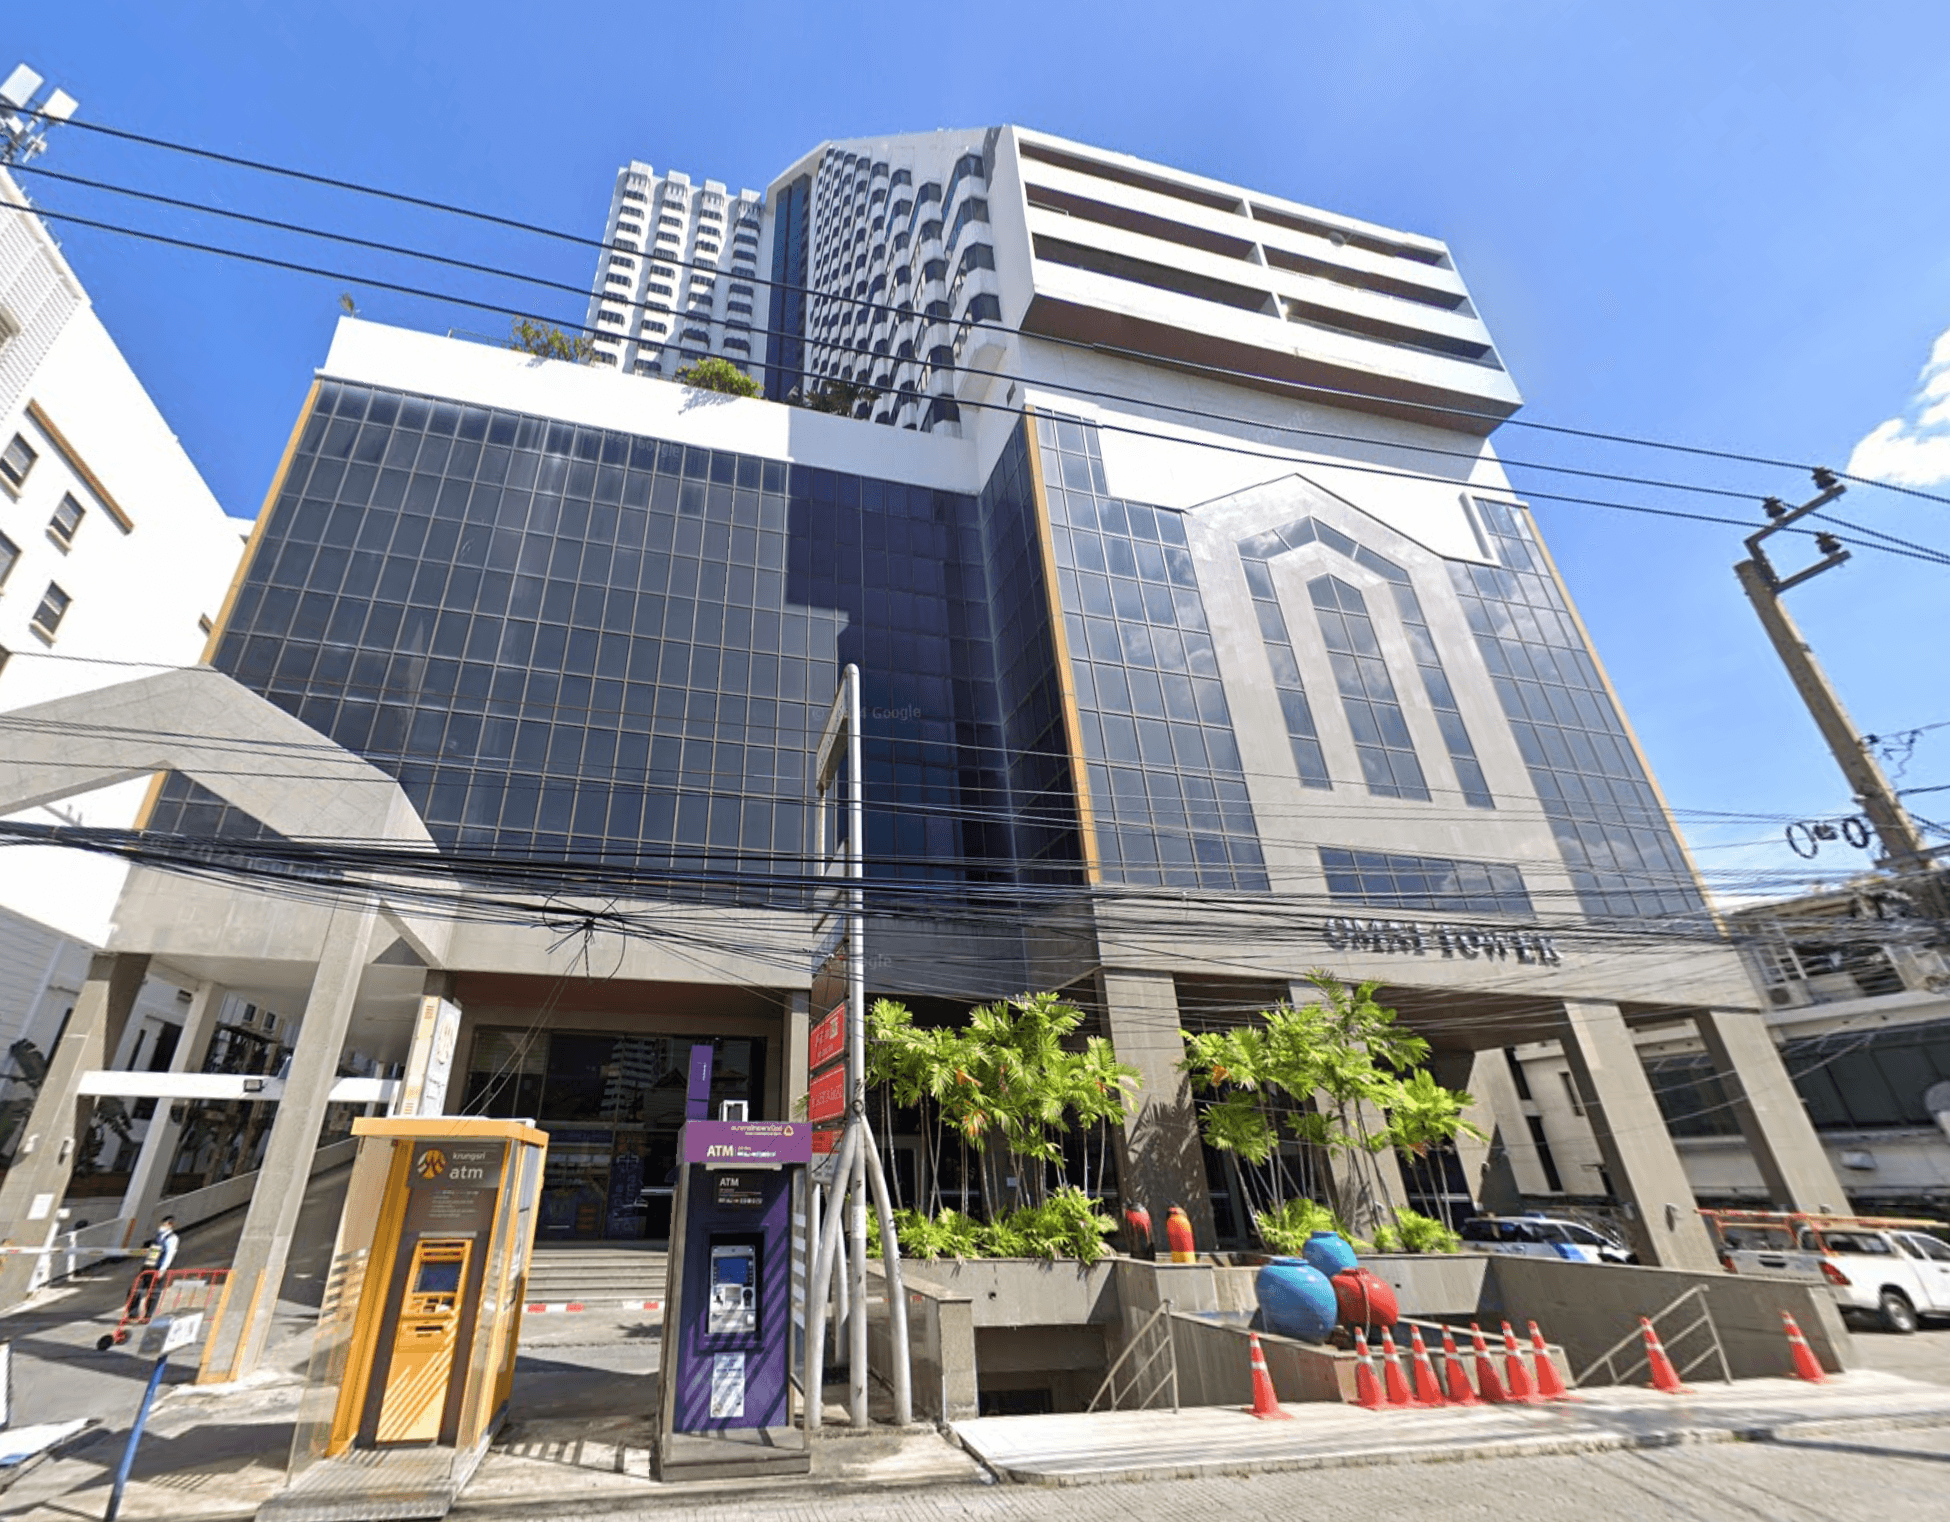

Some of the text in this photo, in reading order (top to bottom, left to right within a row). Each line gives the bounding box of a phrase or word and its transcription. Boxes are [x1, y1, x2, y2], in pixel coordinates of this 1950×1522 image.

[706, 1145, 734, 1157] ATM
[453, 1152, 486, 1162] krungsri
[449, 1165, 483, 1180] atm
[719, 1177, 740, 1187] ATM
